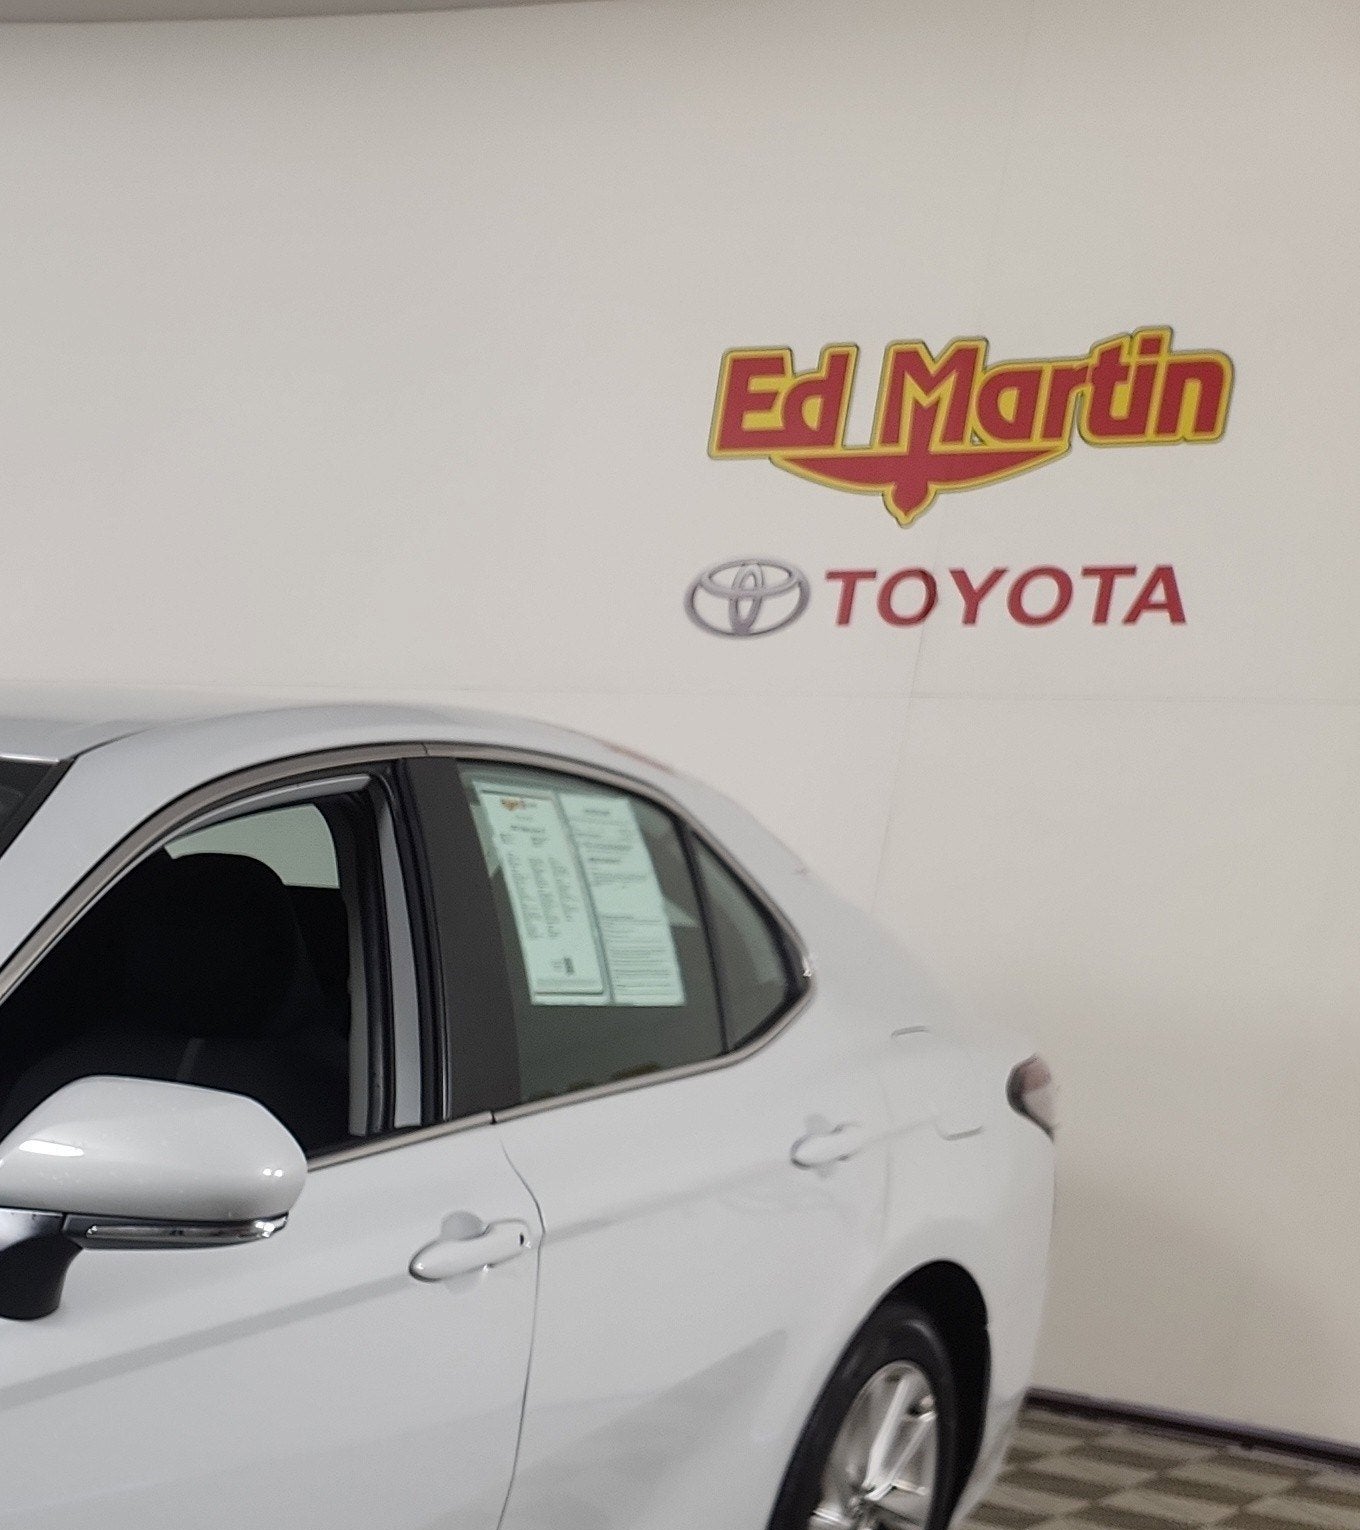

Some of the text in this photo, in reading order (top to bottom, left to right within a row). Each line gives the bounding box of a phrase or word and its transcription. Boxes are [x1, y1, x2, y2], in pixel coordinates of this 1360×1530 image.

[709, 328, 1232, 458] Ed Martin
[825, 564, 1188, 628] TOYOTA
